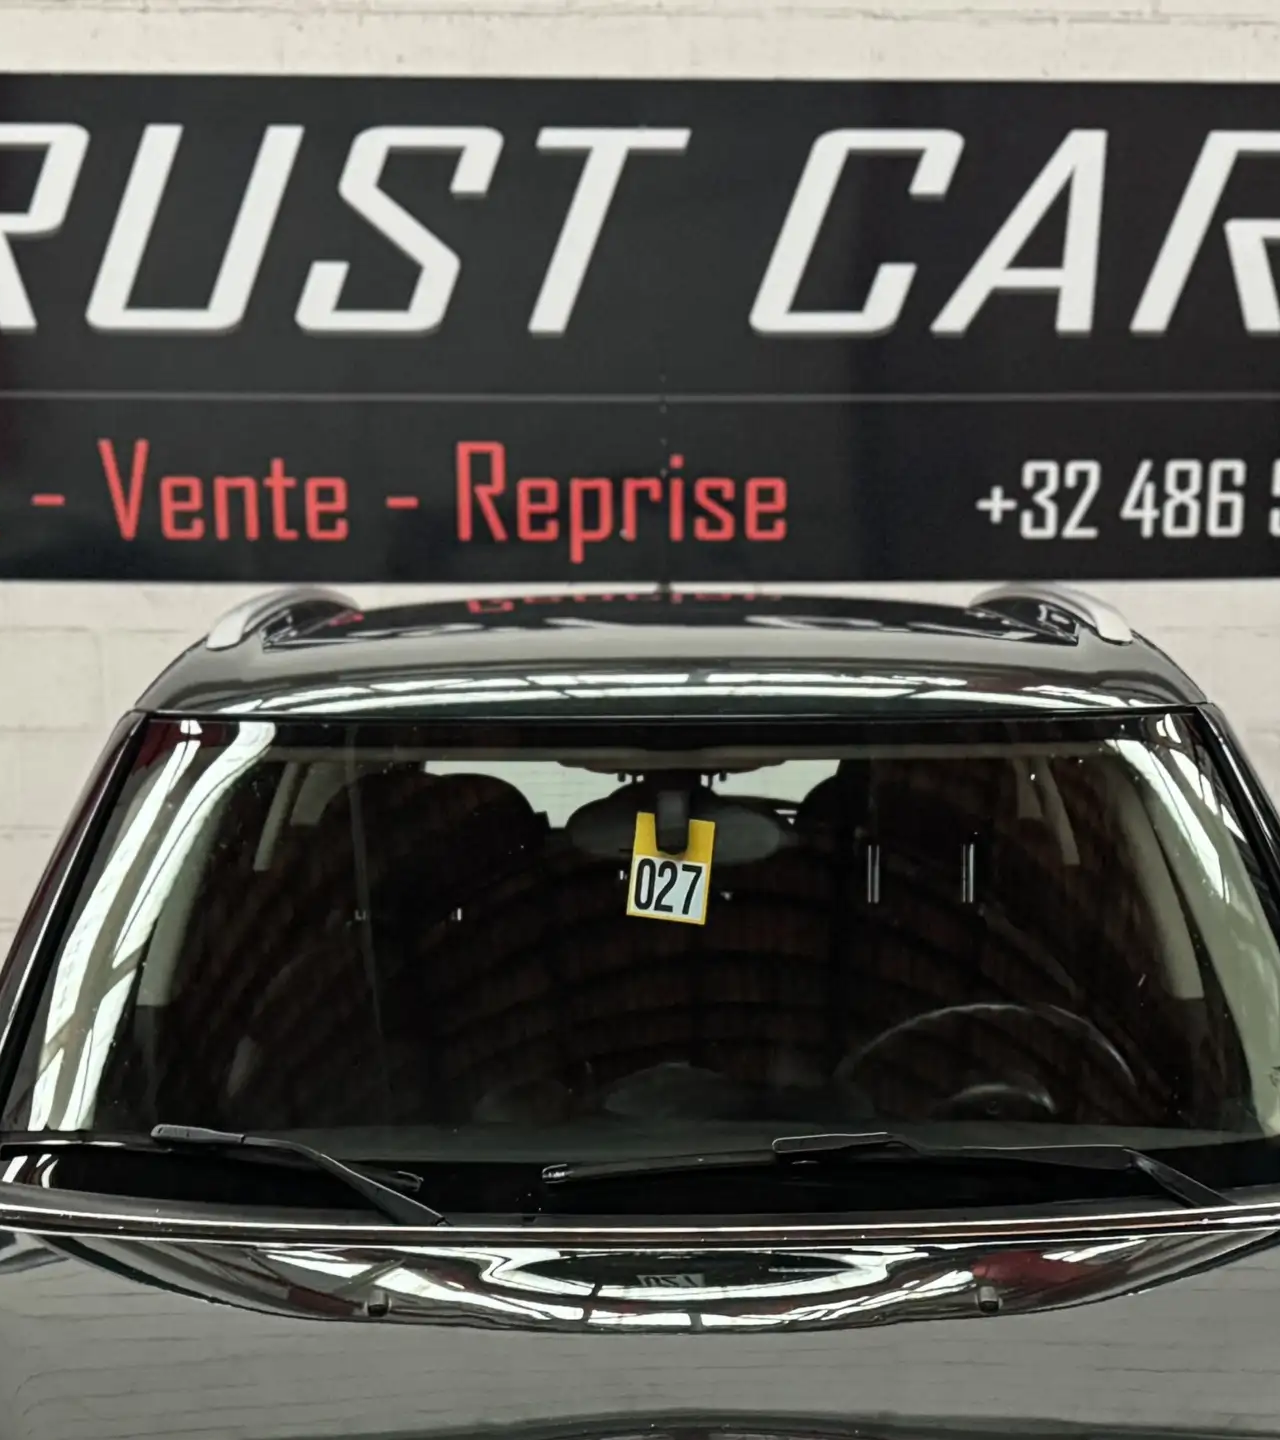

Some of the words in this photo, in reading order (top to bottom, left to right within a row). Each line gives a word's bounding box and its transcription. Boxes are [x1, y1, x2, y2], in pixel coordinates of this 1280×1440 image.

[98, 439, 350, 542] Vente
[456, 440, 789, 565] Reprise
[975, 459, 1102, 540] +32
[1120, 458, 1247, 539] 486
[634, 858, 703, 915] 027
